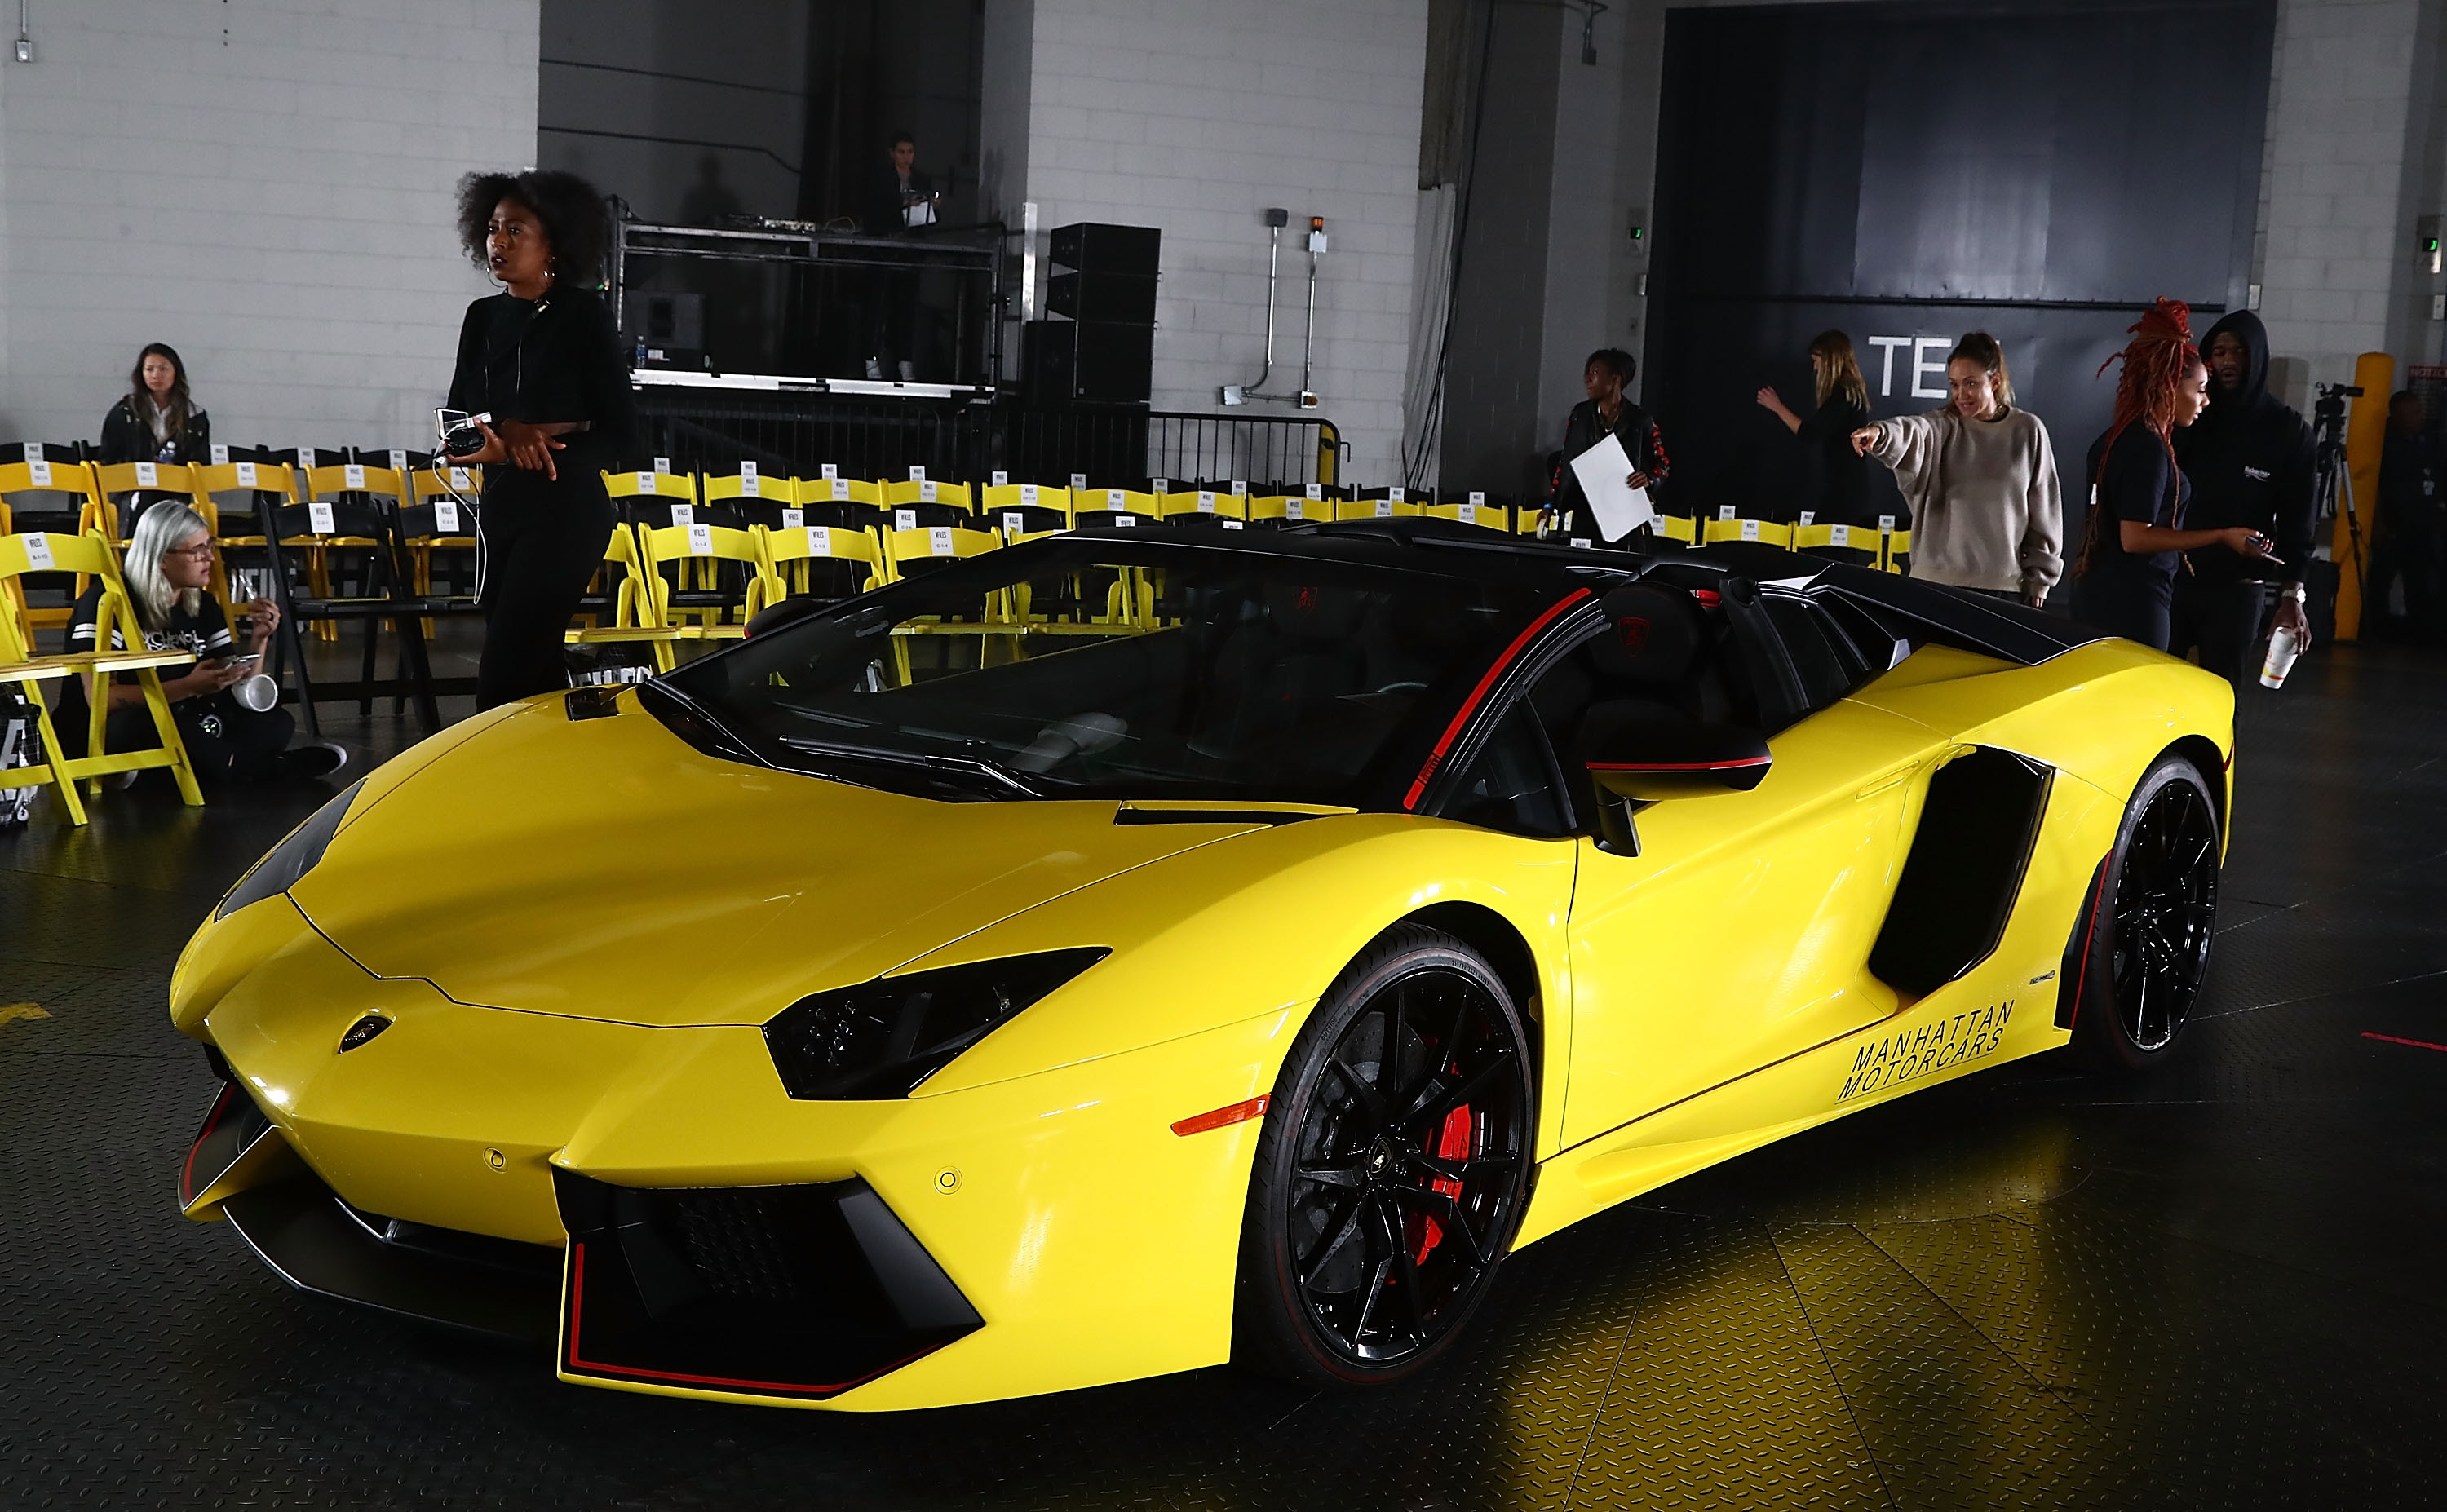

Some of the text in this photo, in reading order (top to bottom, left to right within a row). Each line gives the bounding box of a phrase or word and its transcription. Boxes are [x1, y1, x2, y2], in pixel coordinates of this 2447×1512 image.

[1868, 335, 2000, 399] TE
[1837, 1027, 2004, 1101] MOTORCARS
[1851, 999, 2015, 1074] MANHATTAN
